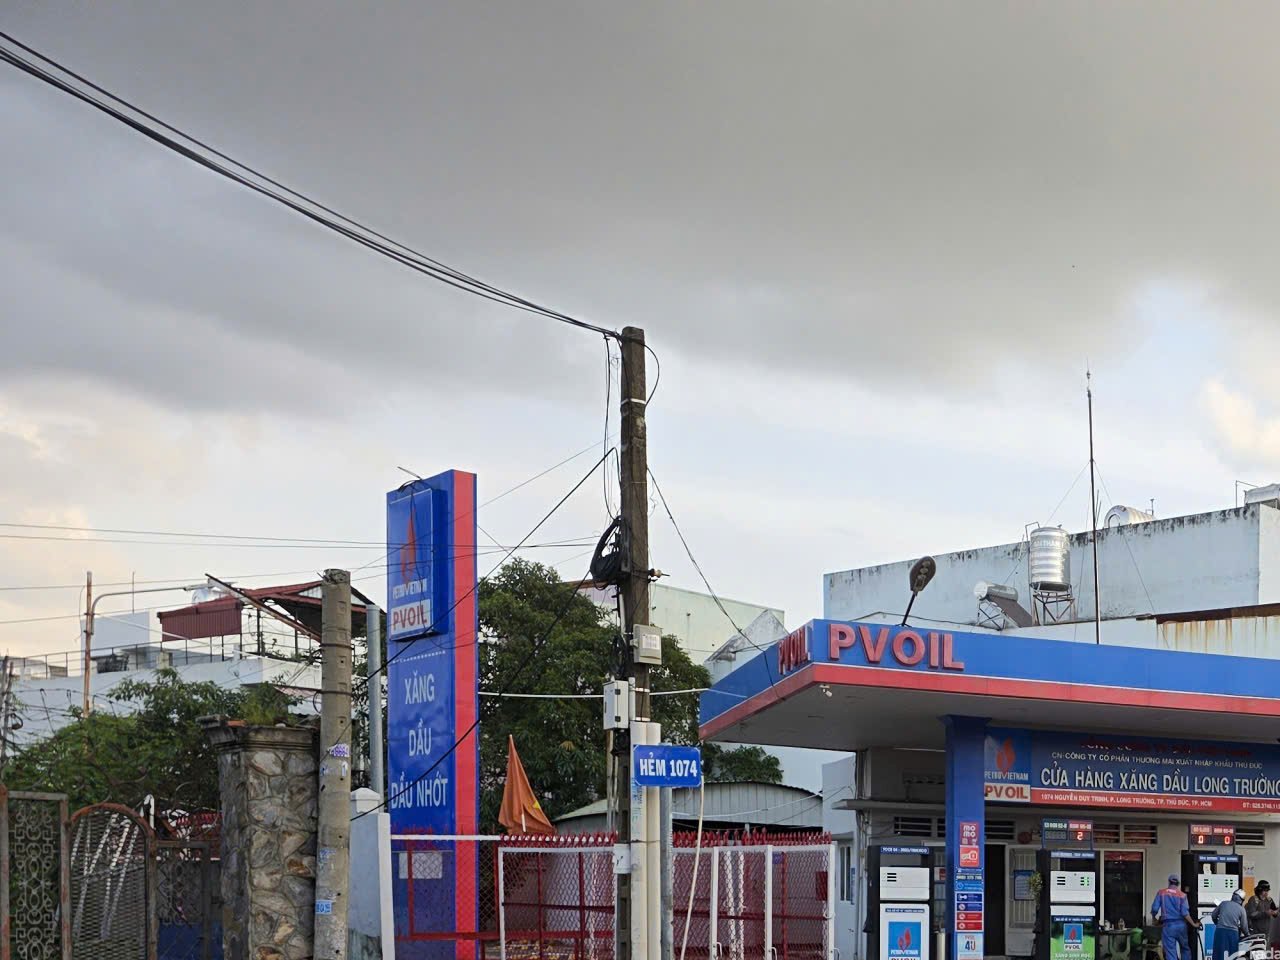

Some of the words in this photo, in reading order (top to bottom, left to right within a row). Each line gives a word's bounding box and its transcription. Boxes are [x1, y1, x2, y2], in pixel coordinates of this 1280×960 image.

[392, 604, 428, 631] PVOIL
[828, 623, 965, 671] PVOIL
[404, 670, 435, 705] XĂNG
[639, 752, 666, 777] HẺM
[669, 759, 698, 778] 1074
[1041, 760, 1069, 787] CỬA
[1075, 766, 1114, 788] HÀNG
[1119, 769, 1158, 791] XĂNG
[1163, 768, 1189, 792] DẦU
[1194, 776, 1229, 794] LONG
[416, 770, 448, 808] NHỚT
[1224, 836, 1231, 844] 0
